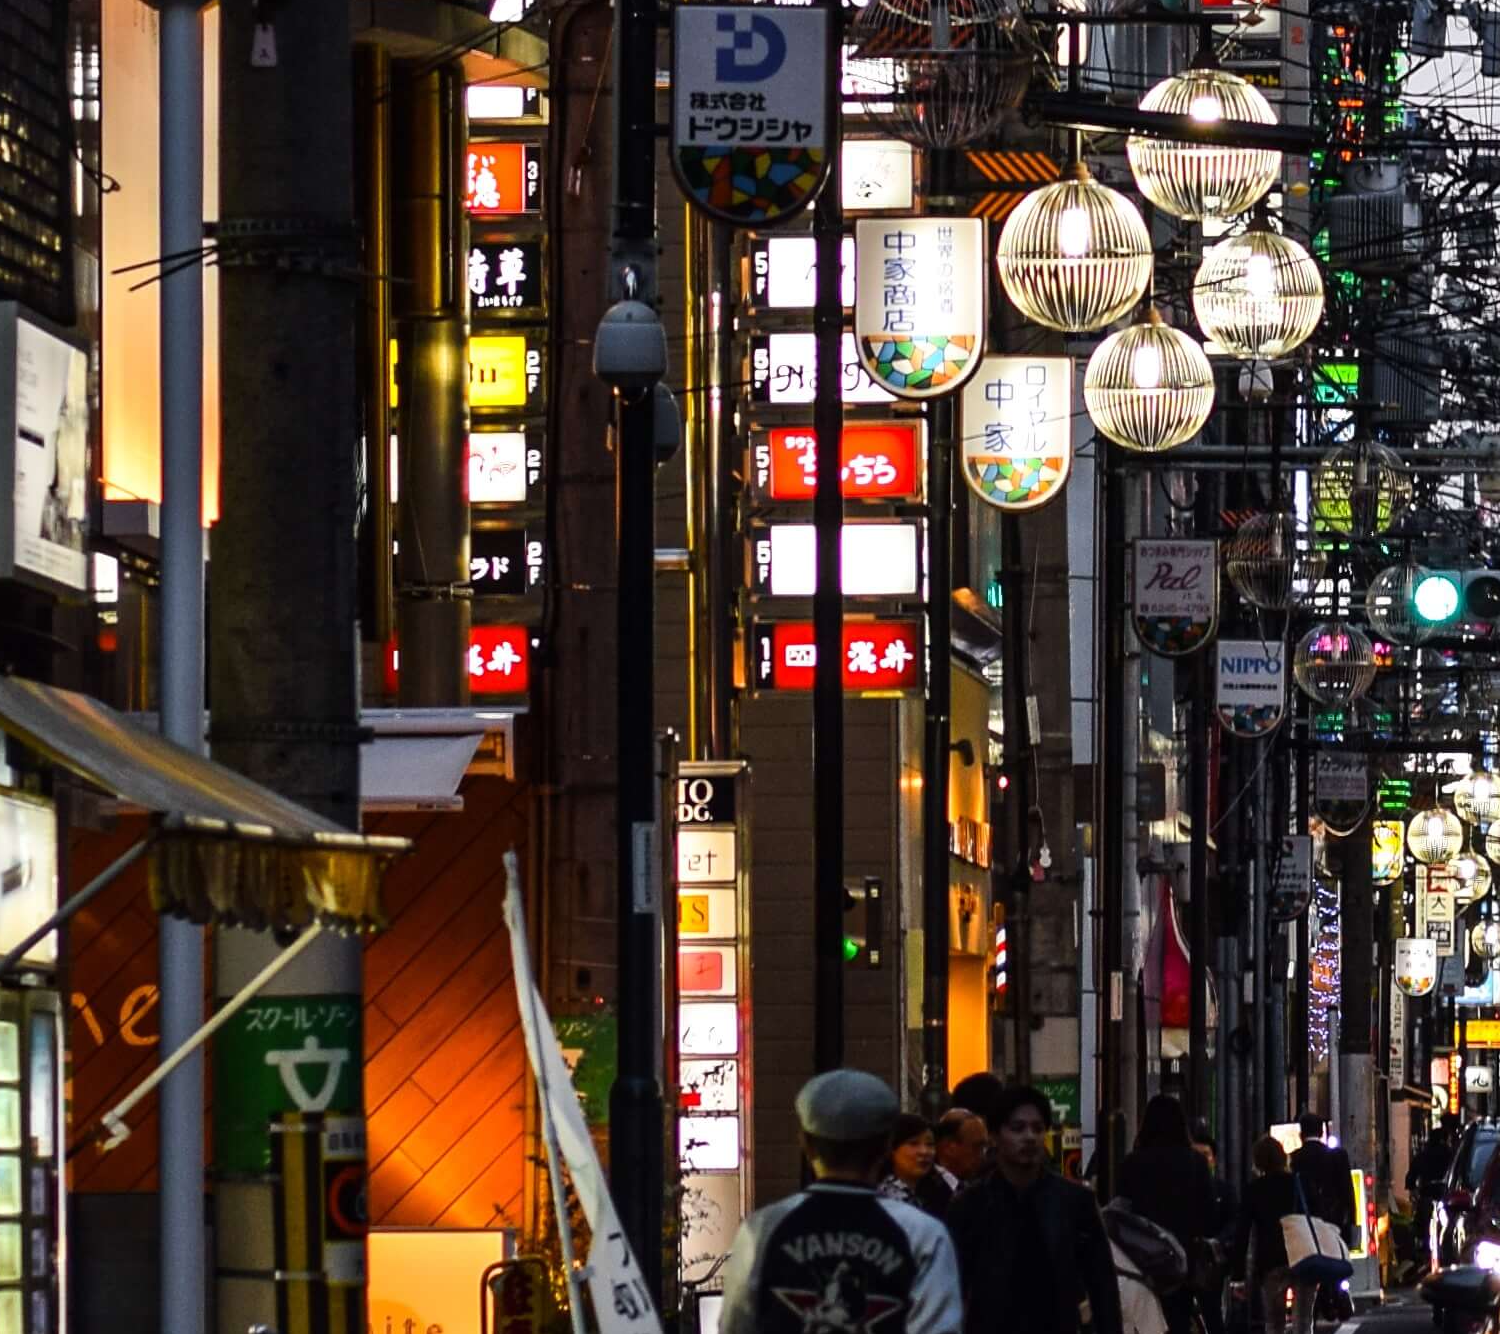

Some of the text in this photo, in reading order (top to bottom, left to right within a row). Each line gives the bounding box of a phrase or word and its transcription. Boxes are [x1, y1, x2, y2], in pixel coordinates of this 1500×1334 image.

[690, 91, 766, 111] 株式会社
[688, 116, 813, 143] ドウシシャ
[754, 250, 768, 295] 5F
[883, 230, 917, 332] 中家商店
[984, 377, 1014, 452] 中家
[1025, 365, 1047, 452] ロイヤル
[755, 445, 770, 488] 5F
[1144, 562, 1201, 590] Pal
[1220, 657, 1282, 675] NIPPO
[780, 1230, 904, 1276] VANSON
